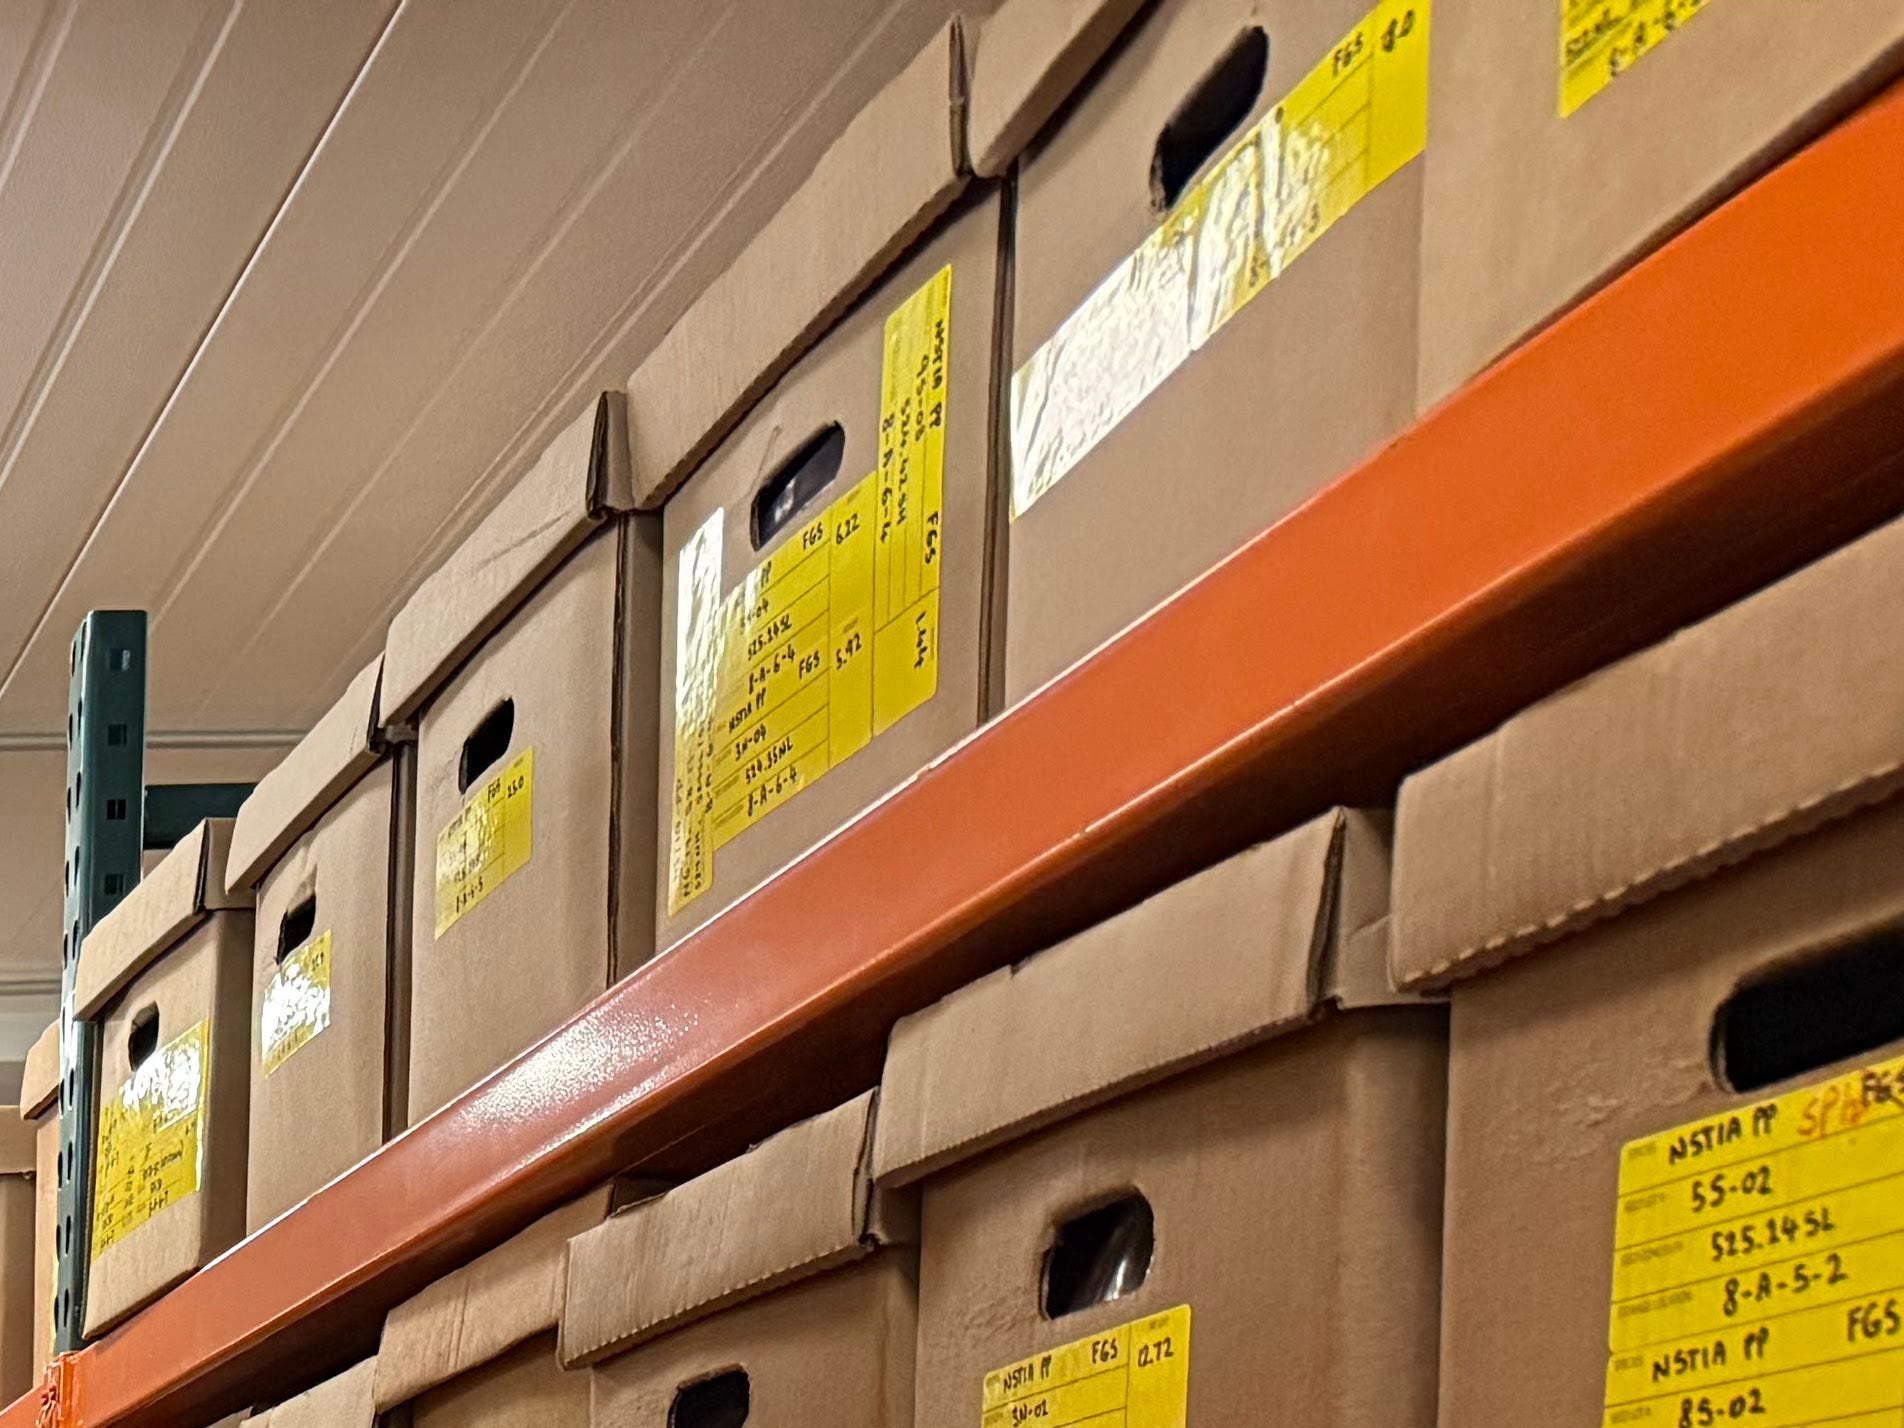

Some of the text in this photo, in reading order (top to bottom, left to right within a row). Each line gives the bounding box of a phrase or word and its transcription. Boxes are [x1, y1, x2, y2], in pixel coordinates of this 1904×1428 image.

[1668, 1102, 1779, 1166] NSTIA PP
[1090, 1339, 1119, 1366] FGS
[1651, 1297, 1901, 1383] NSTIA PP FGS
